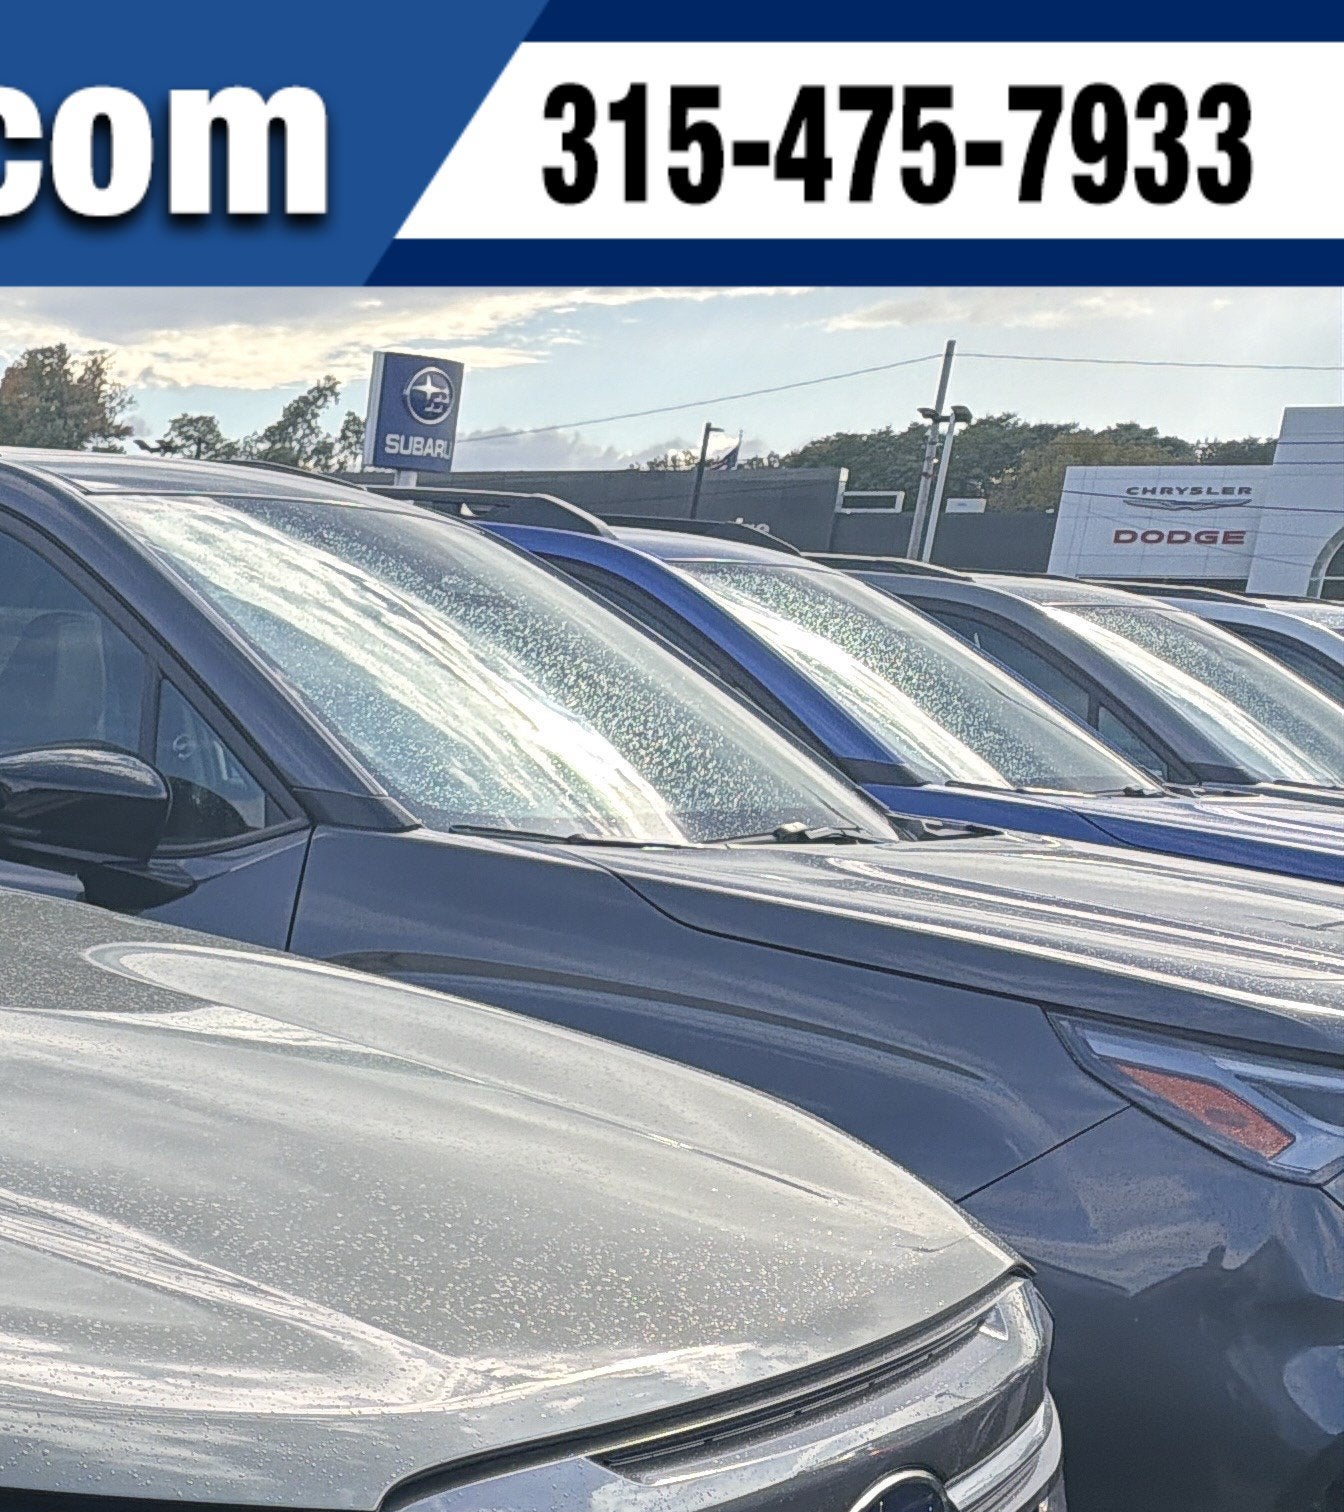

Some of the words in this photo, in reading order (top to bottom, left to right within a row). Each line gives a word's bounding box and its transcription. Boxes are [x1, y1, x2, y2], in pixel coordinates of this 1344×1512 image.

[384, 433, 452, 460] SUBARU
[1125, 486, 1253, 496] CHRYSLER
[1113, 529, 1247, 545] DODGE
